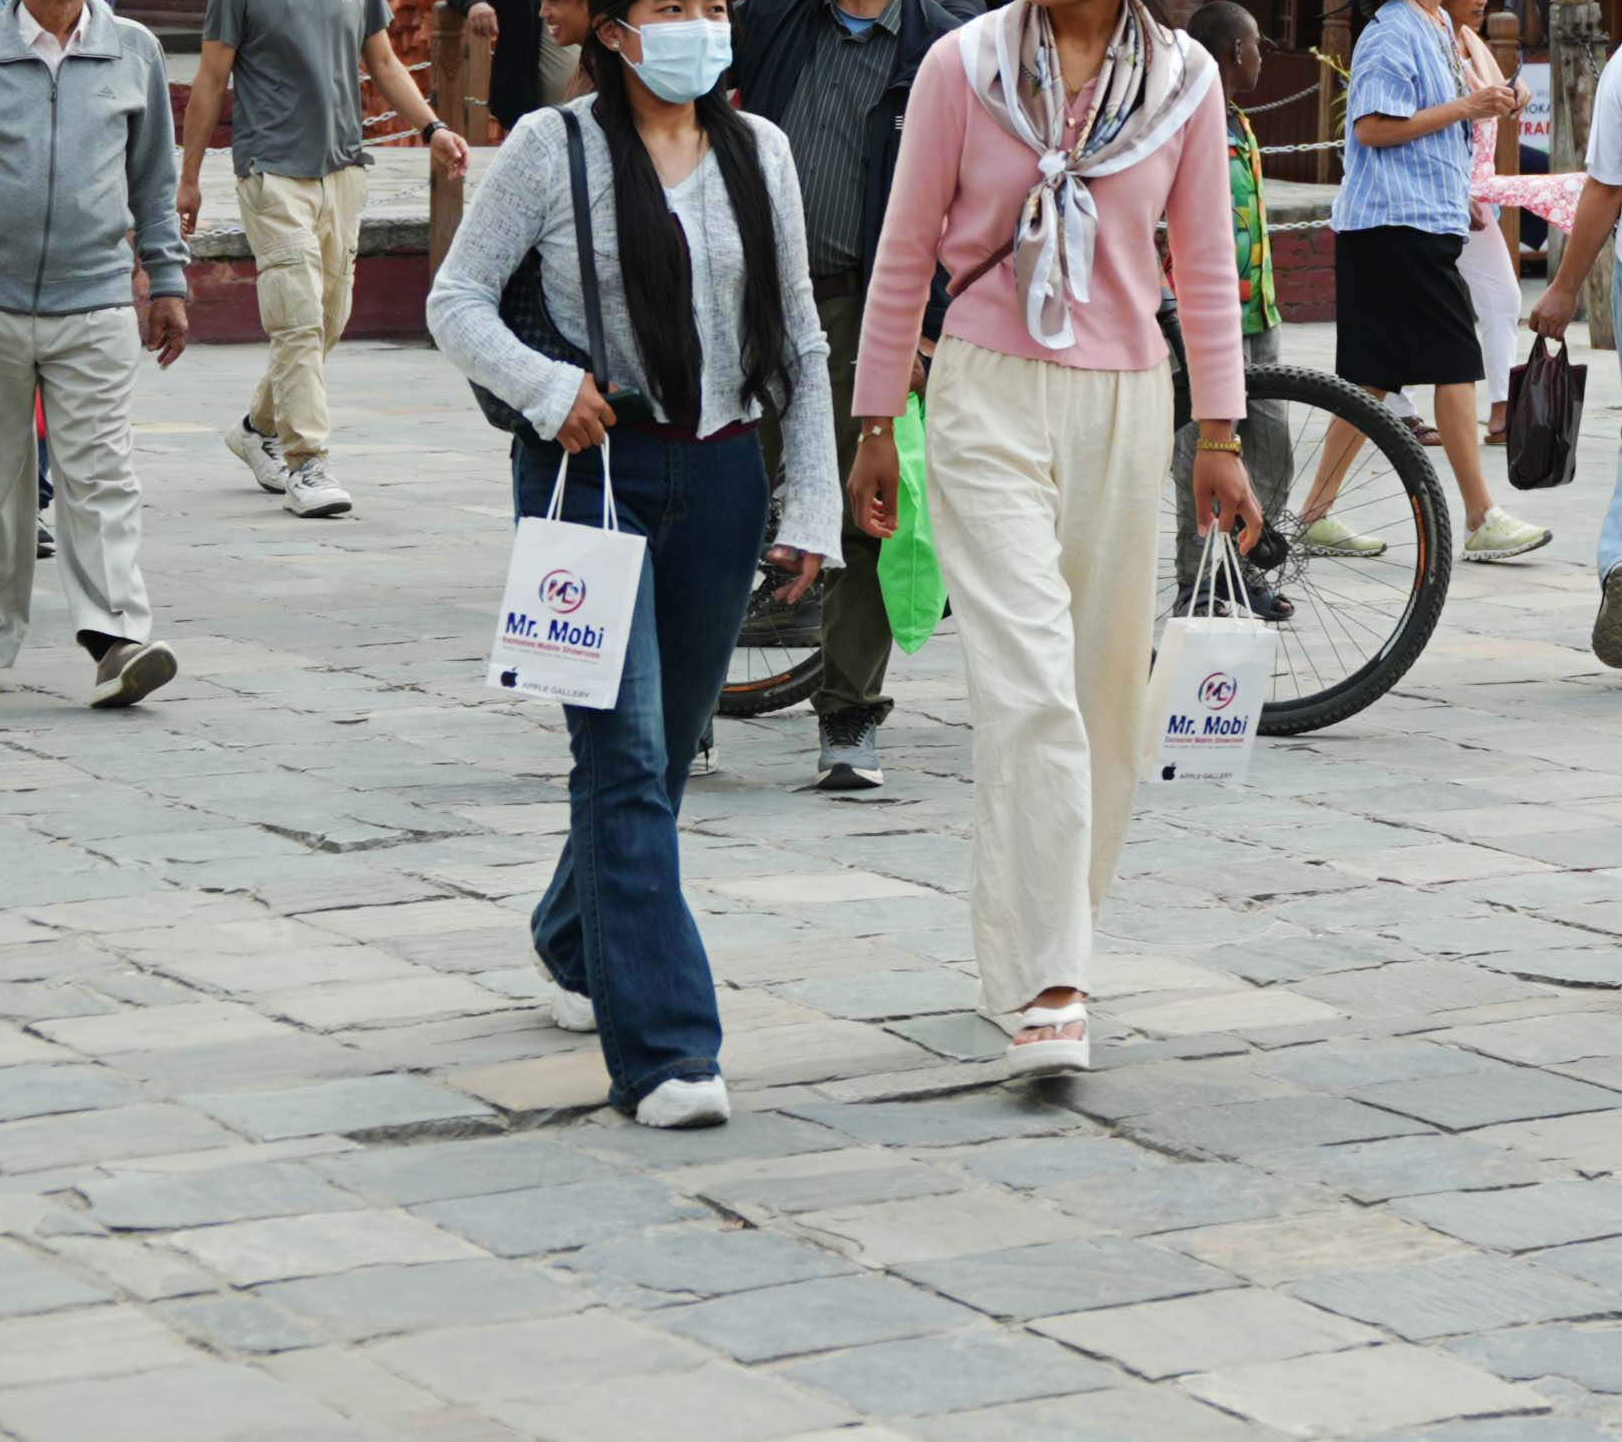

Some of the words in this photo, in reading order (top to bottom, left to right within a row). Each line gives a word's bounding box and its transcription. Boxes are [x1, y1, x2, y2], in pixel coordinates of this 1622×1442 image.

[505, 612, 538, 638] Mr.
[547, 619, 604, 649] Mobi
[1167, 715, 1196, 735] Mr.
[1203, 715, 1249, 735] Mobi
